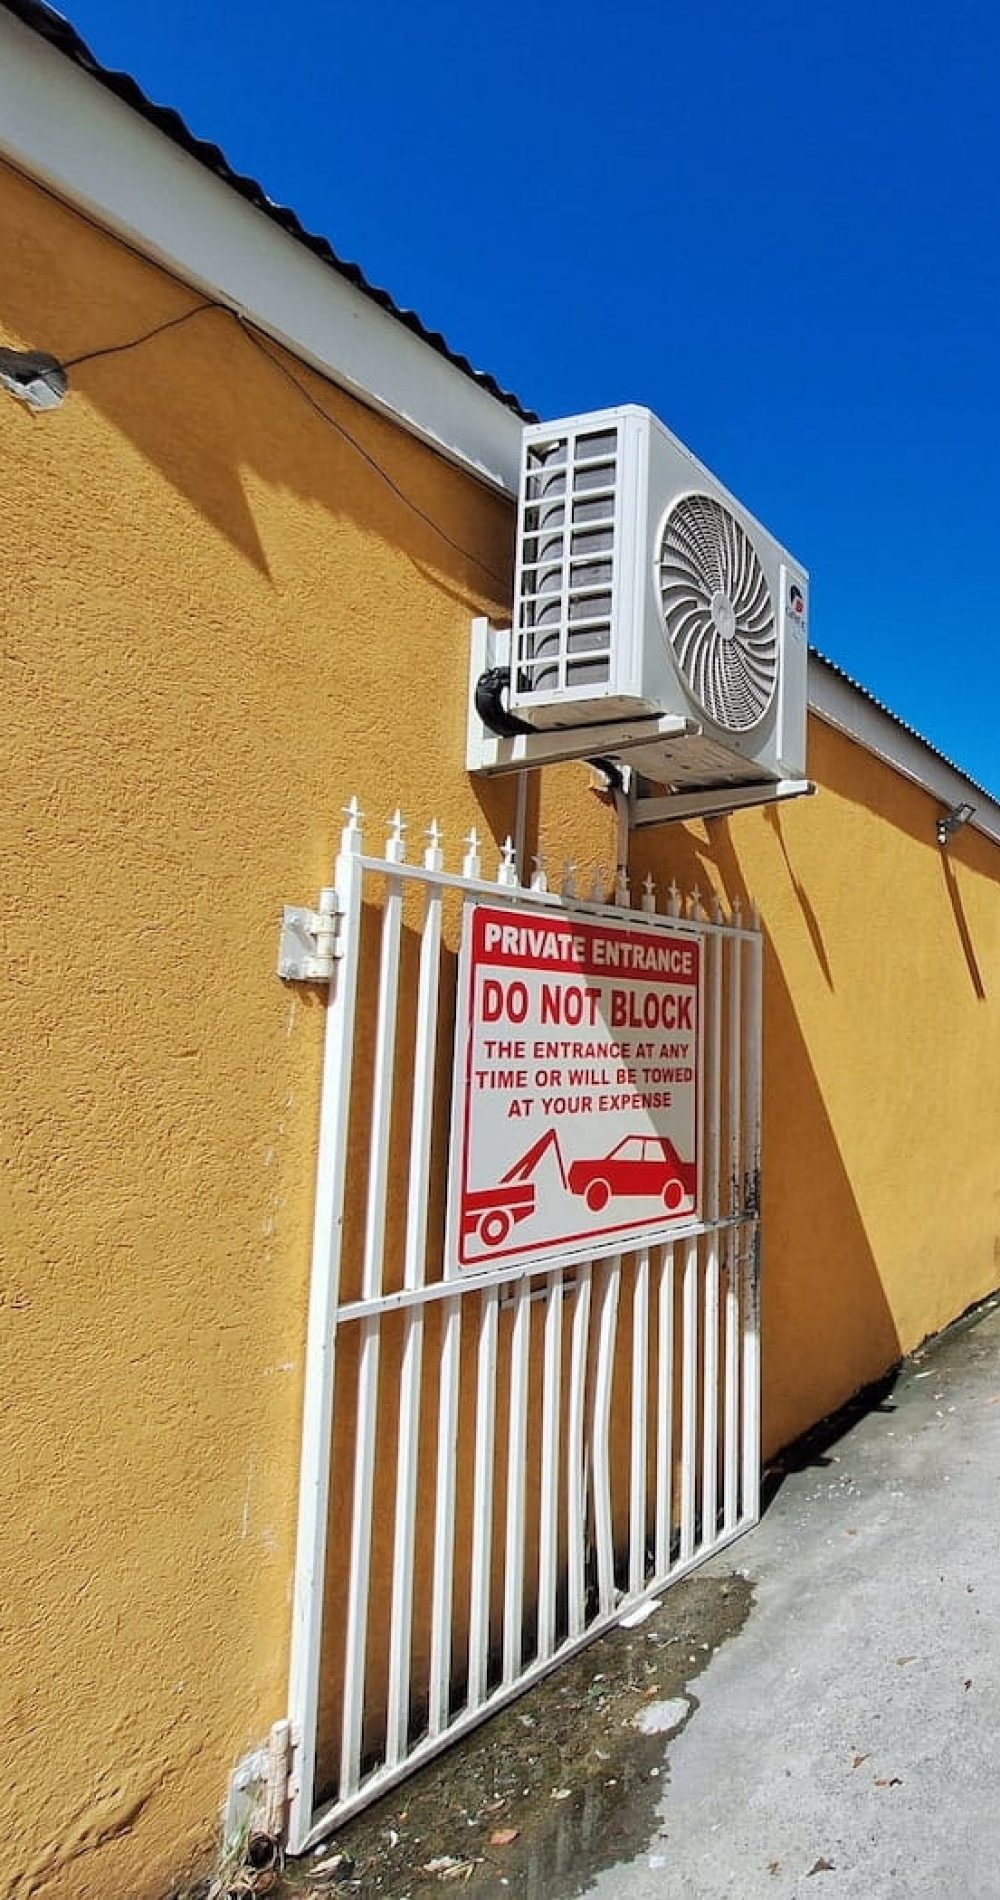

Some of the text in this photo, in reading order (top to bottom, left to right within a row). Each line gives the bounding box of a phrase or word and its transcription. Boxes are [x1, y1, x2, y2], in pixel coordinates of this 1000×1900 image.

[484, 922, 693, 974] PRIVATE ENTRANCE
[482, 979, 693, 1030] DO NOT BLOCK
[484, 1041, 690, 1059] THE ENTRANCE AT ANY
[475, 1067, 693, 1089] TIME OR WILL BE TOWED
[508, 1092, 672, 1118] AT YOUR EXPENSE
